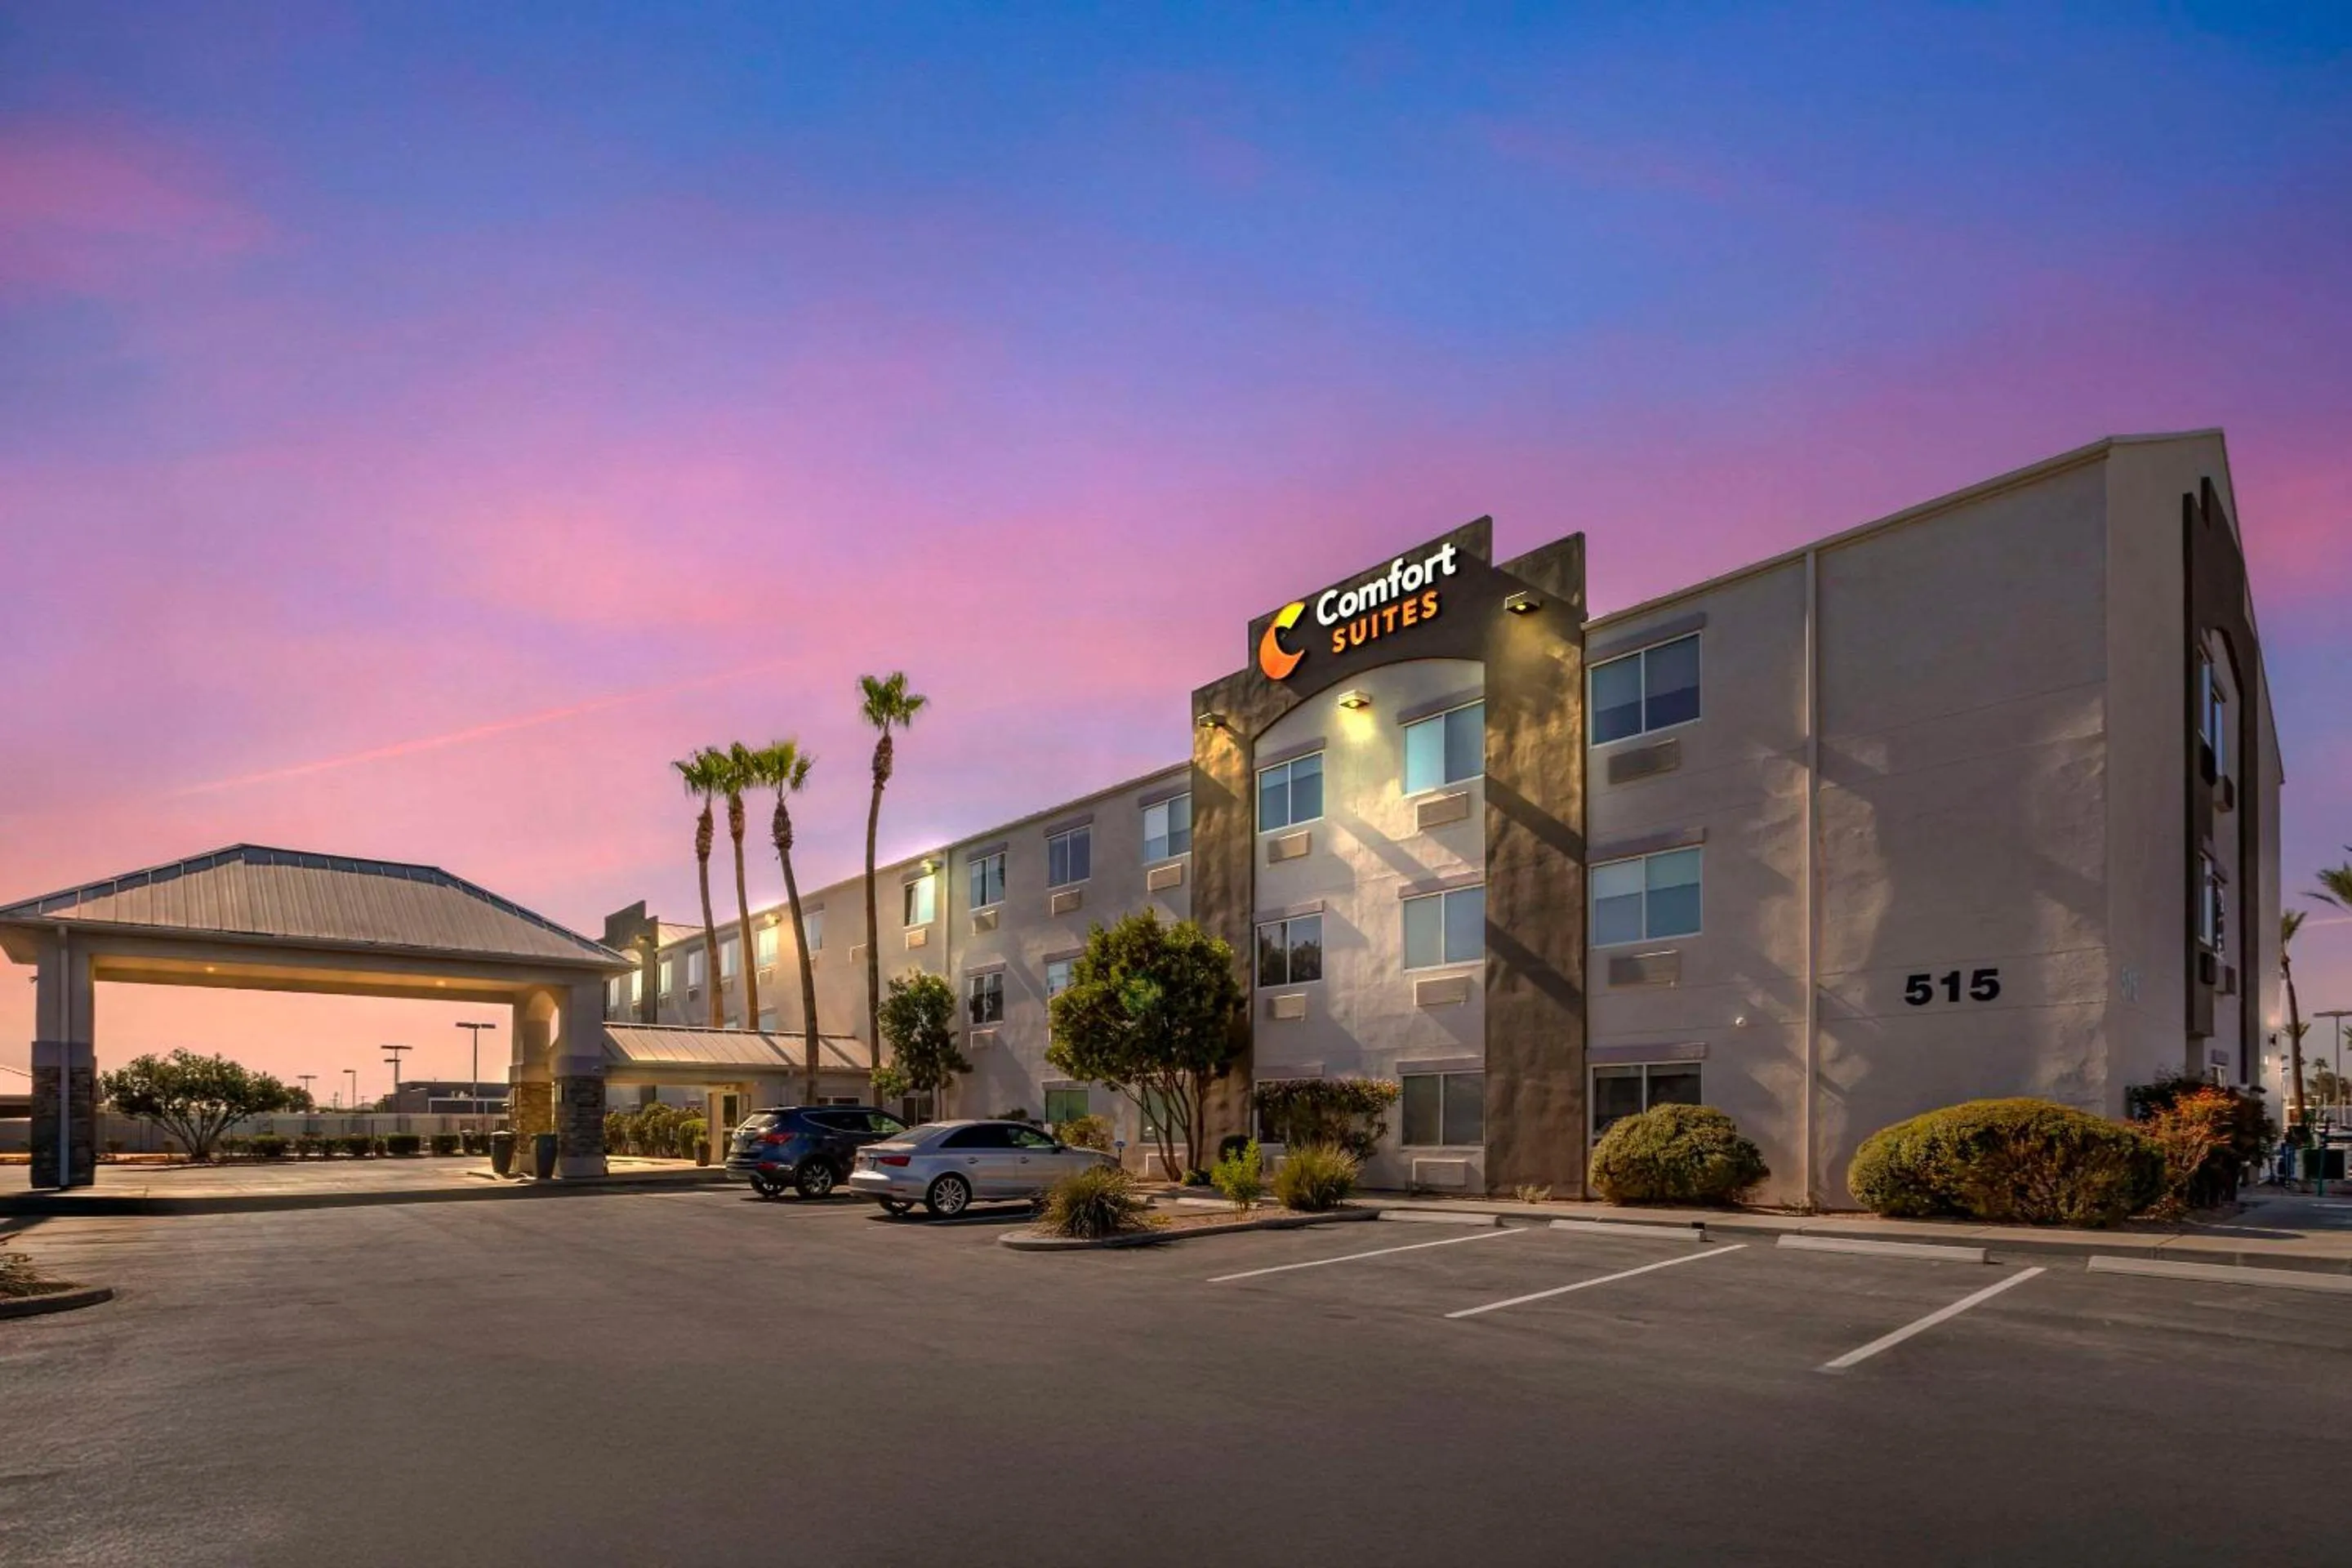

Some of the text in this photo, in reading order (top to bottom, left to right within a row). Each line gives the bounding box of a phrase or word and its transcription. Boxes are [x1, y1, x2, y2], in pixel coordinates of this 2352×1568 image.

[1316, 542, 1456, 626] Comfort
[1332, 590, 1438, 653] SUITES
[1904, 968, 2000, 1005] 515
